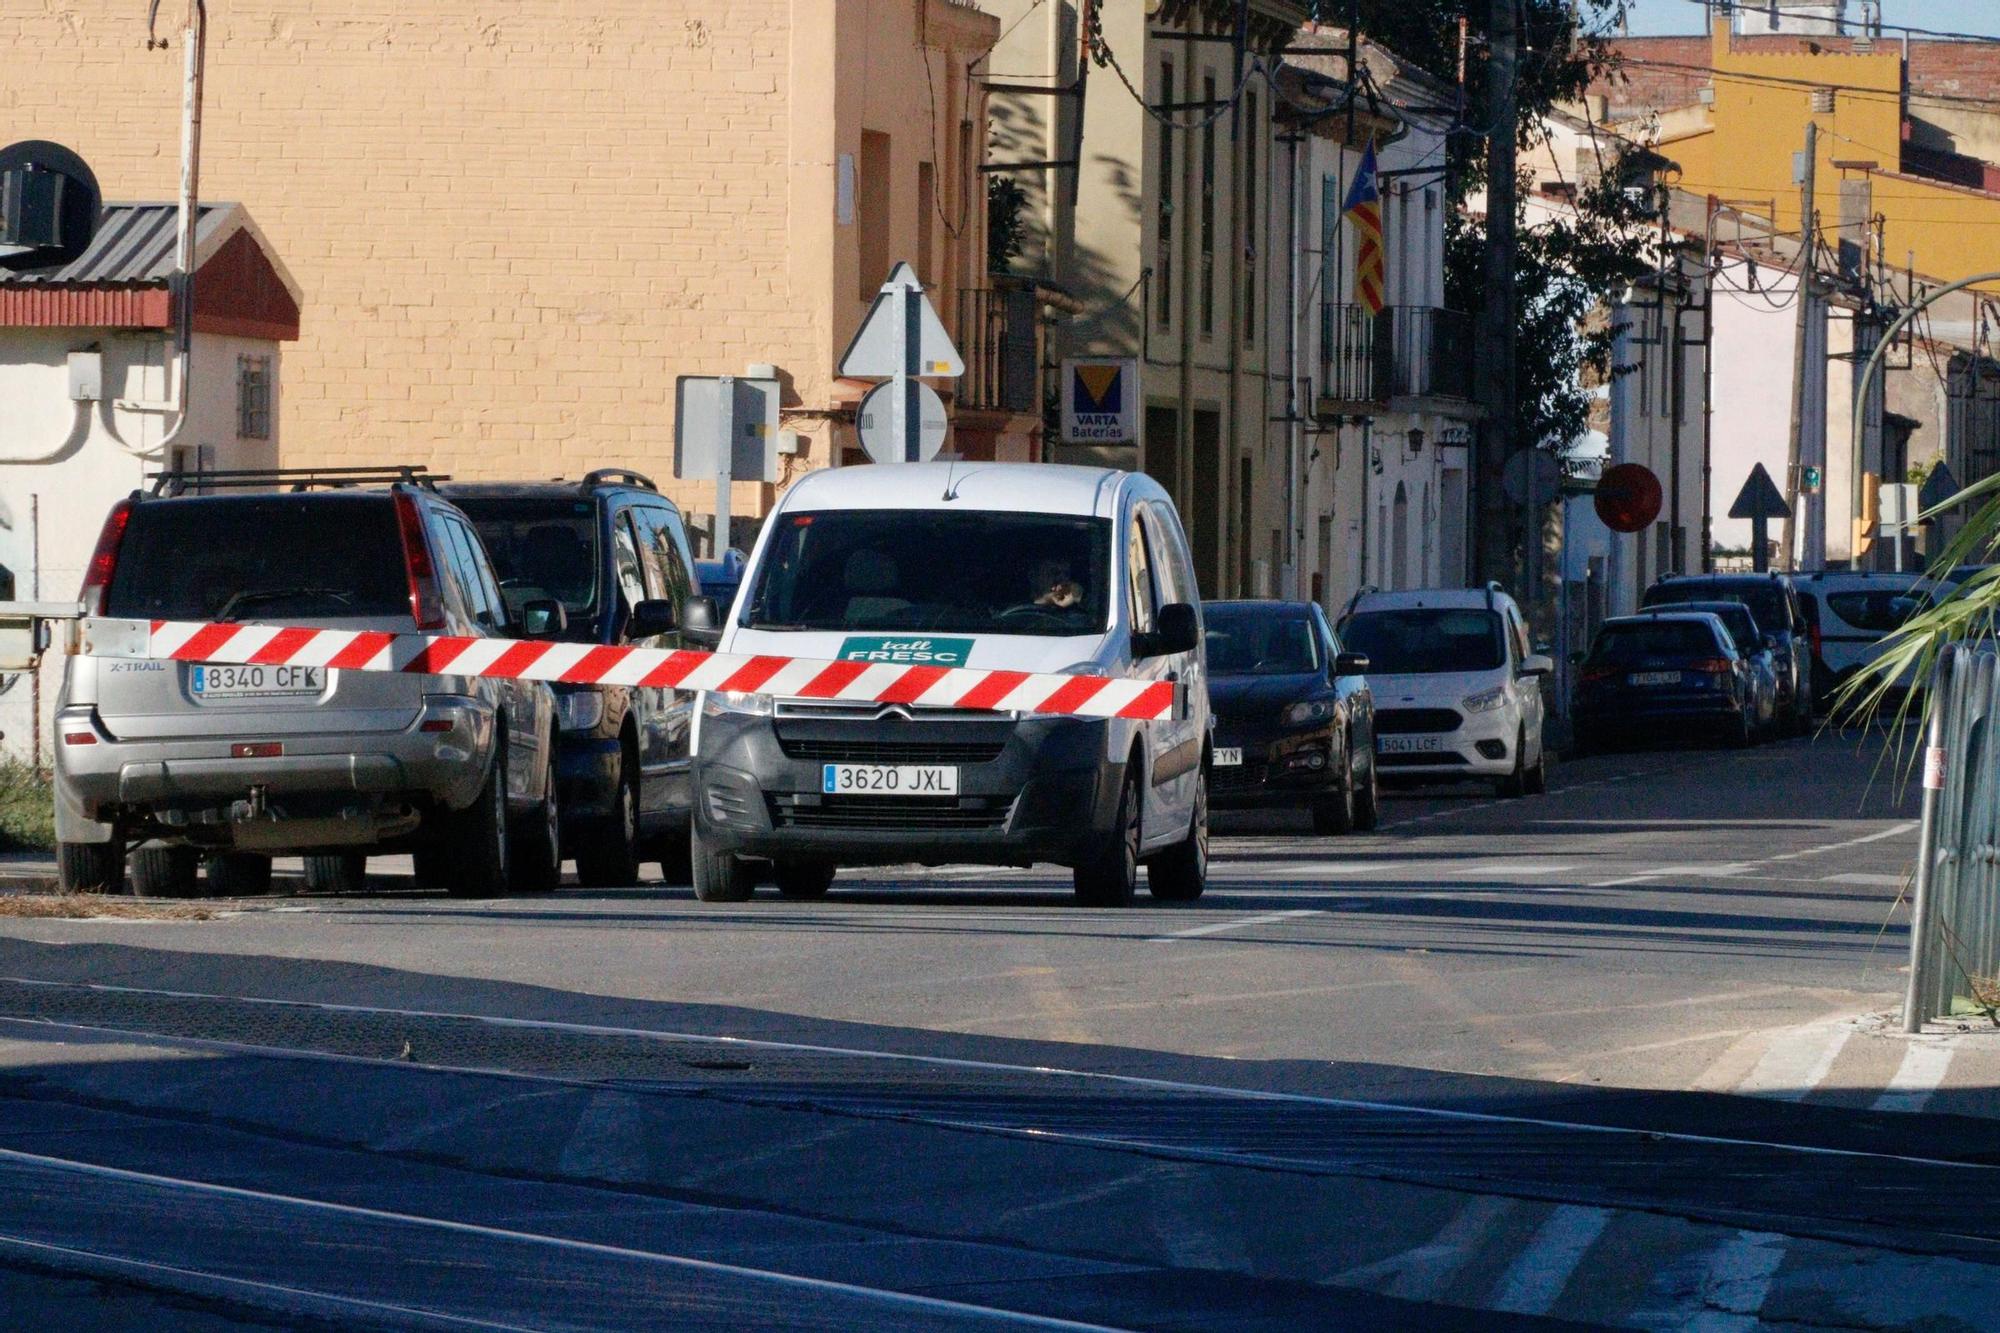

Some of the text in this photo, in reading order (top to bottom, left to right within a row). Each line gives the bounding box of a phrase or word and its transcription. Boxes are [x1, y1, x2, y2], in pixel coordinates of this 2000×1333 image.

[1076, 414, 1119, 425] VARTA
[1072, 426, 1122, 438] Baterías
[881, 640, 932, 650] tall
[847, 651, 958, 662] FRESC
[110, 661, 165, 672] X-TRAIL
[209, 666, 318, 688] 8340 CFK
[841, 768, 899, 790] 3620
[908, 769, 951, 790] JXL
